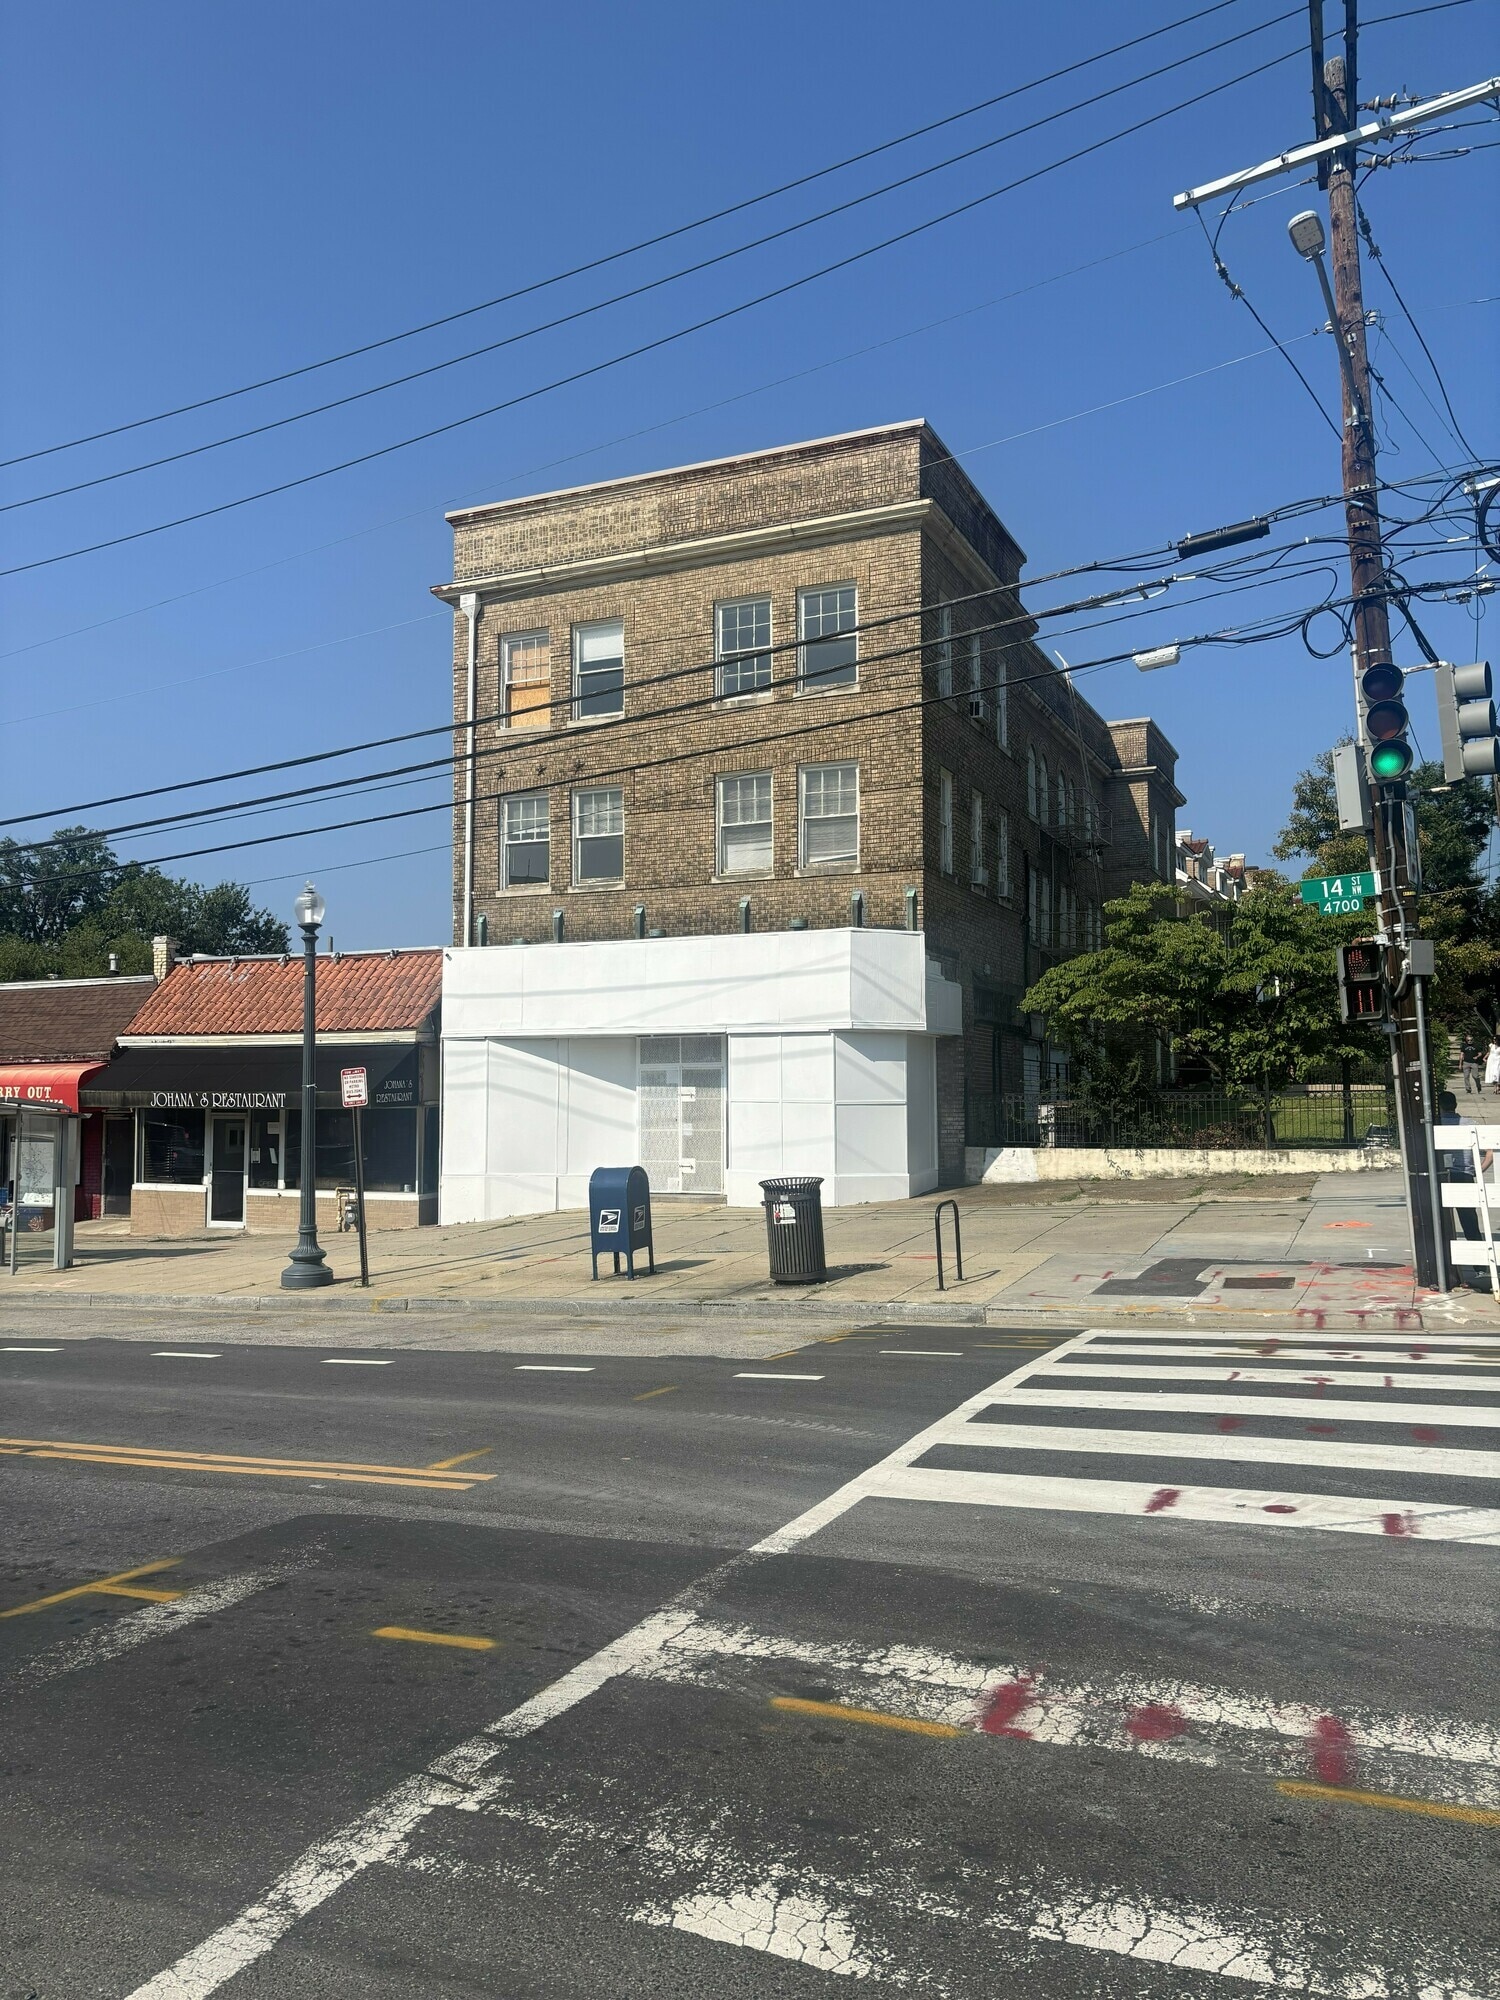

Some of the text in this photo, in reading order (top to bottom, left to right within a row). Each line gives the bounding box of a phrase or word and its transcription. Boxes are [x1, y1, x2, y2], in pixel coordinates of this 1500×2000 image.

[1321, 876, 1361, 898] 14 ST
[1352, 886, 1362, 895] NW
[1323, 899, 1360, 914] 4700
[27, 1086, 52, 1099] OUT
[376, 1092, 413, 1103] RESTAURANT
[212, 1092, 286, 1108] RESTAURANT
